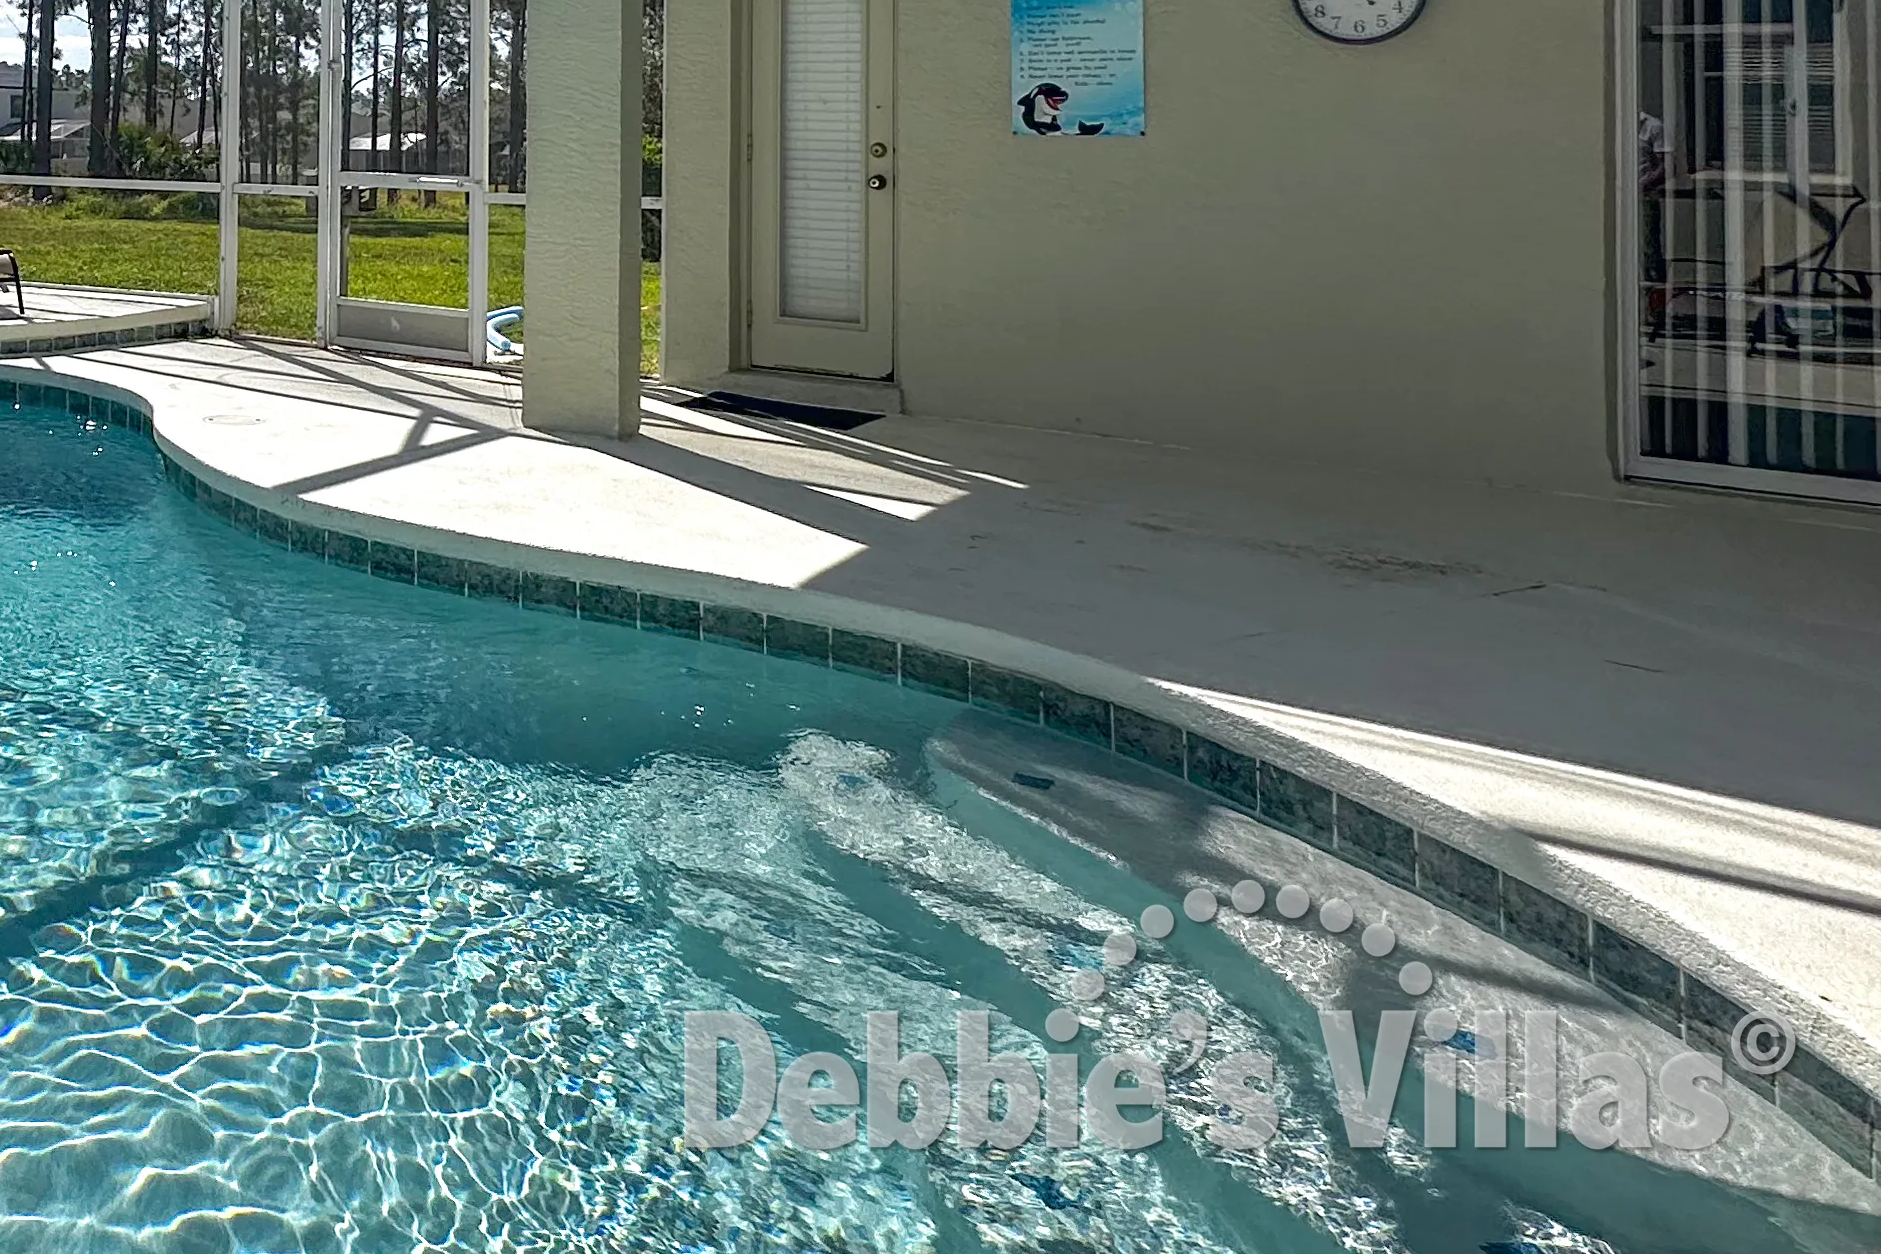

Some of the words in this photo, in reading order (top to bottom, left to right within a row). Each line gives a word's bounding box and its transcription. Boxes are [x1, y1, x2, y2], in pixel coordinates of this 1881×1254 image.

[1314, 4, 1326, 18] 8
[1392, 0, 1404, 13] 4
[1330, 16, 1342, 30] 7
[1353, 20, 1365, 33] 6
[1376, 14, 1388, 28] 5
